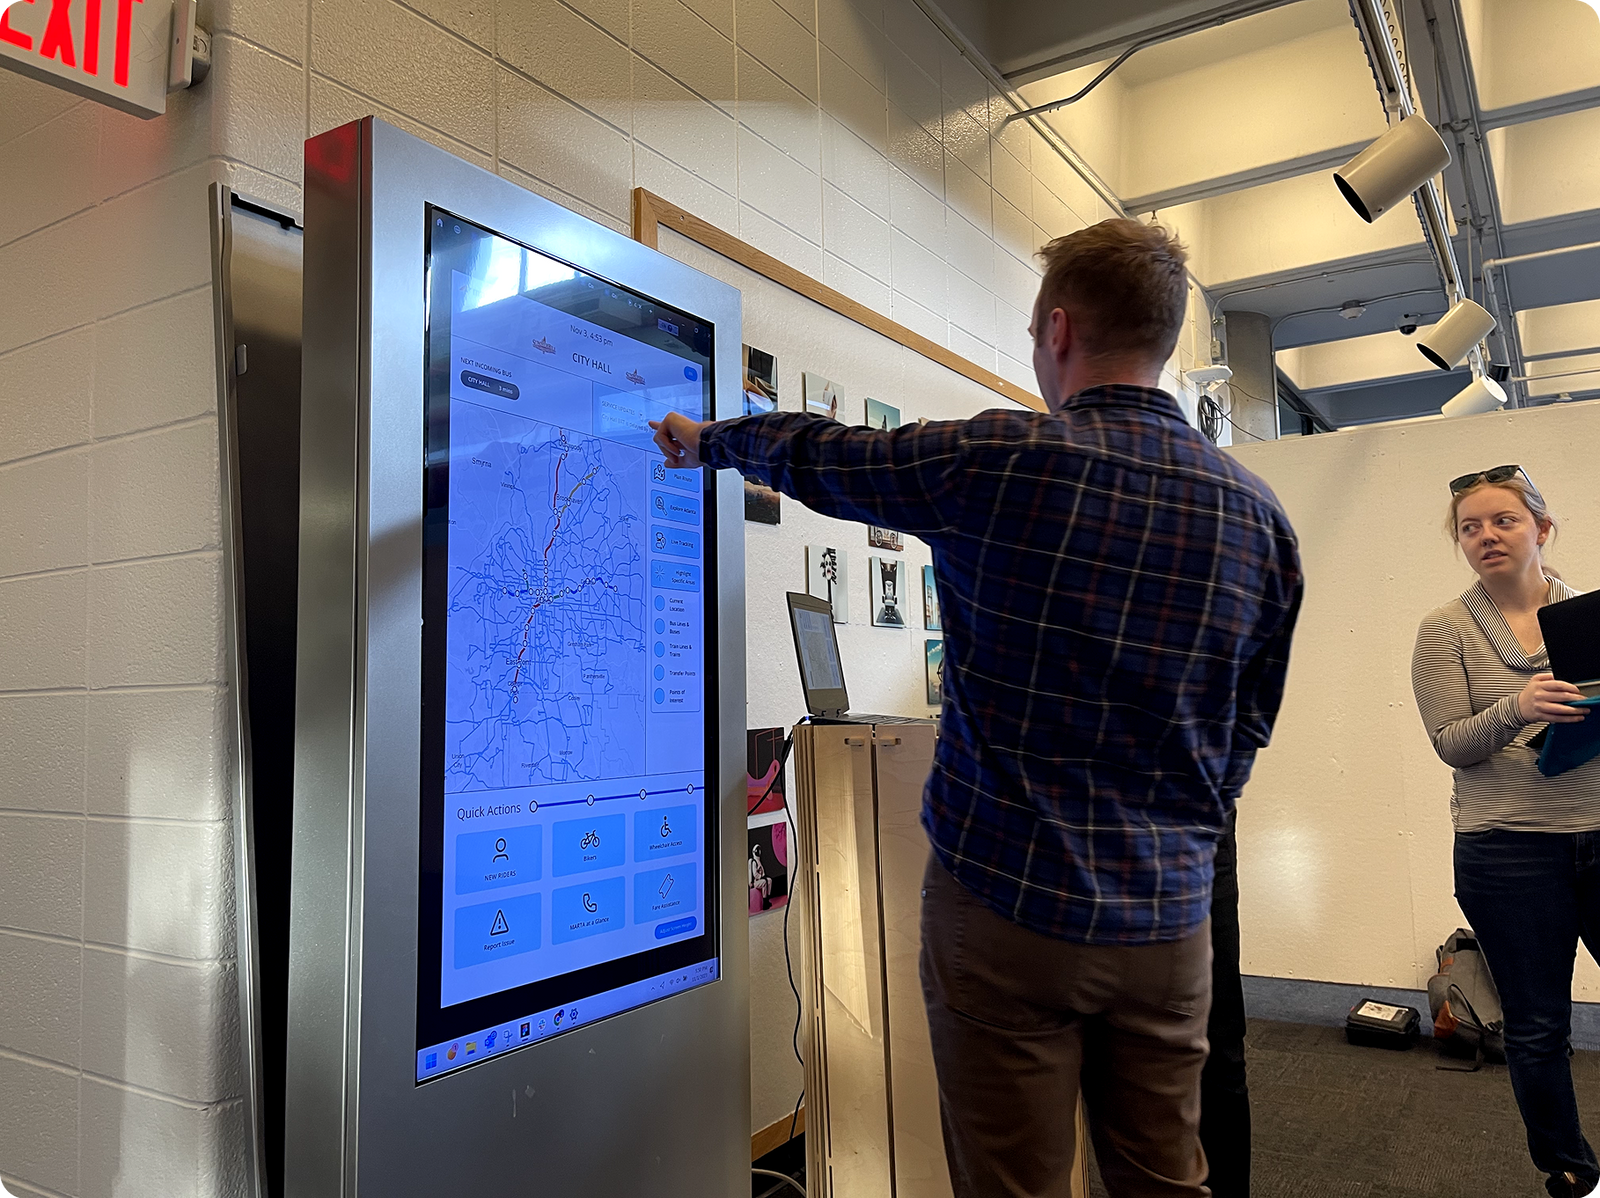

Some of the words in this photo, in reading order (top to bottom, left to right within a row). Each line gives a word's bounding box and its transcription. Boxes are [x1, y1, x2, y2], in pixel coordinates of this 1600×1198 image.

[570, 324, 583, 337] Nov
[583, 330, 589, 339] 3,
[590, 332, 602, 343] 4:53
[603, 337, 613, 347] pm
[460, 357, 474, 366] NEXT
[474, 362, 501, 375] INCOMING
[502, 369, 512, 378] BUS
[572, 352, 590, 366] CITY
[592, 358, 612, 374] HALL
[467, 376, 478, 384] CITY
[478, 379, 490, 388] HALL
[457, 805, 485, 821] Quick
[486, 803, 521, 816] Actions
[583, 854, 597, 862] Bikers
[484, 873, 498, 881] NEW
[499, 870, 517, 880] RIDERS
[569, 921, 585, 931] MARTA
[595, 916, 609, 925] Glance
[483, 941, 501, 951] Report
[501, 939, 515, 947] Issue
